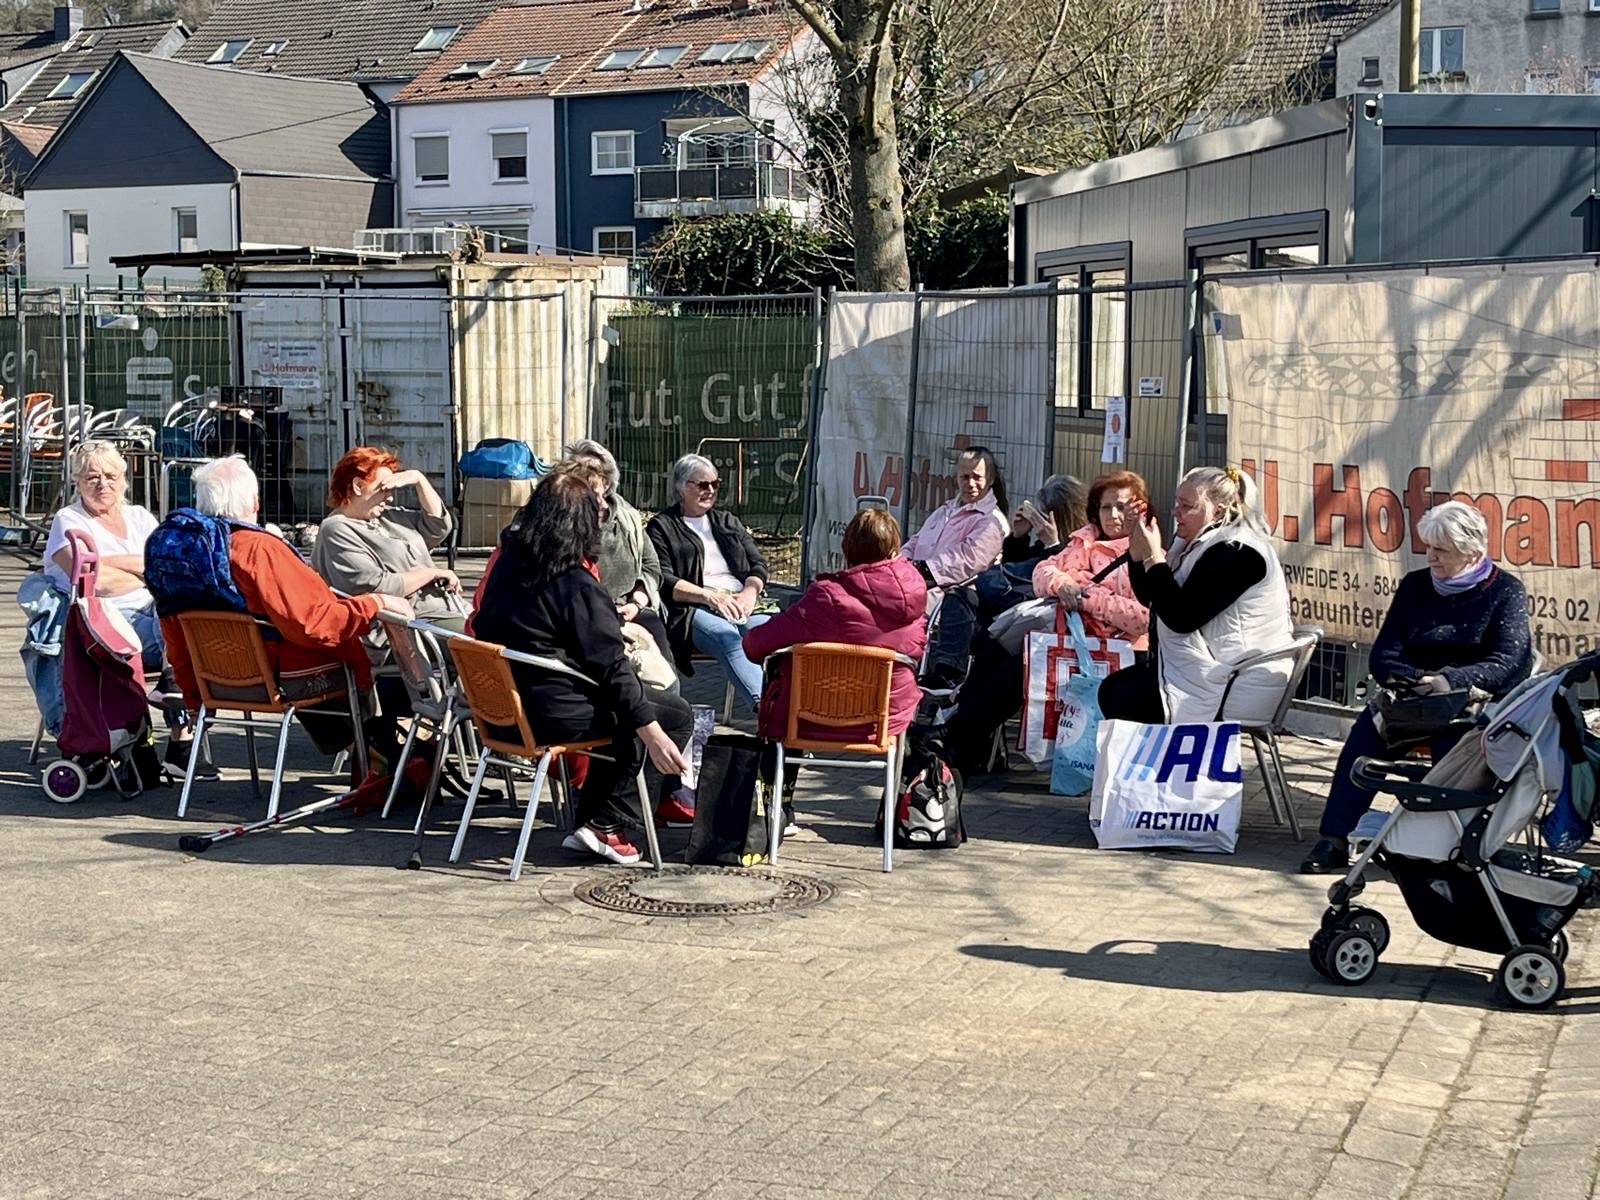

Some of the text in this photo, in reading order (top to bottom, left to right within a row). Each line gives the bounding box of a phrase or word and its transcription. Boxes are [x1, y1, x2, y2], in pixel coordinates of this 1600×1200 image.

[701, 372, 787, 424] Gut
[1281, 563, 1401, 597] RWEIDE 34 584
[1289, 590, 1389, 629] bauunter
[1565, 598, 1590, 622] 02
[1534, 623, 1600, 658] fma
[1070, 760, 1095, 772] ISANA
[1135, 811, 1219, 832] ACTION
